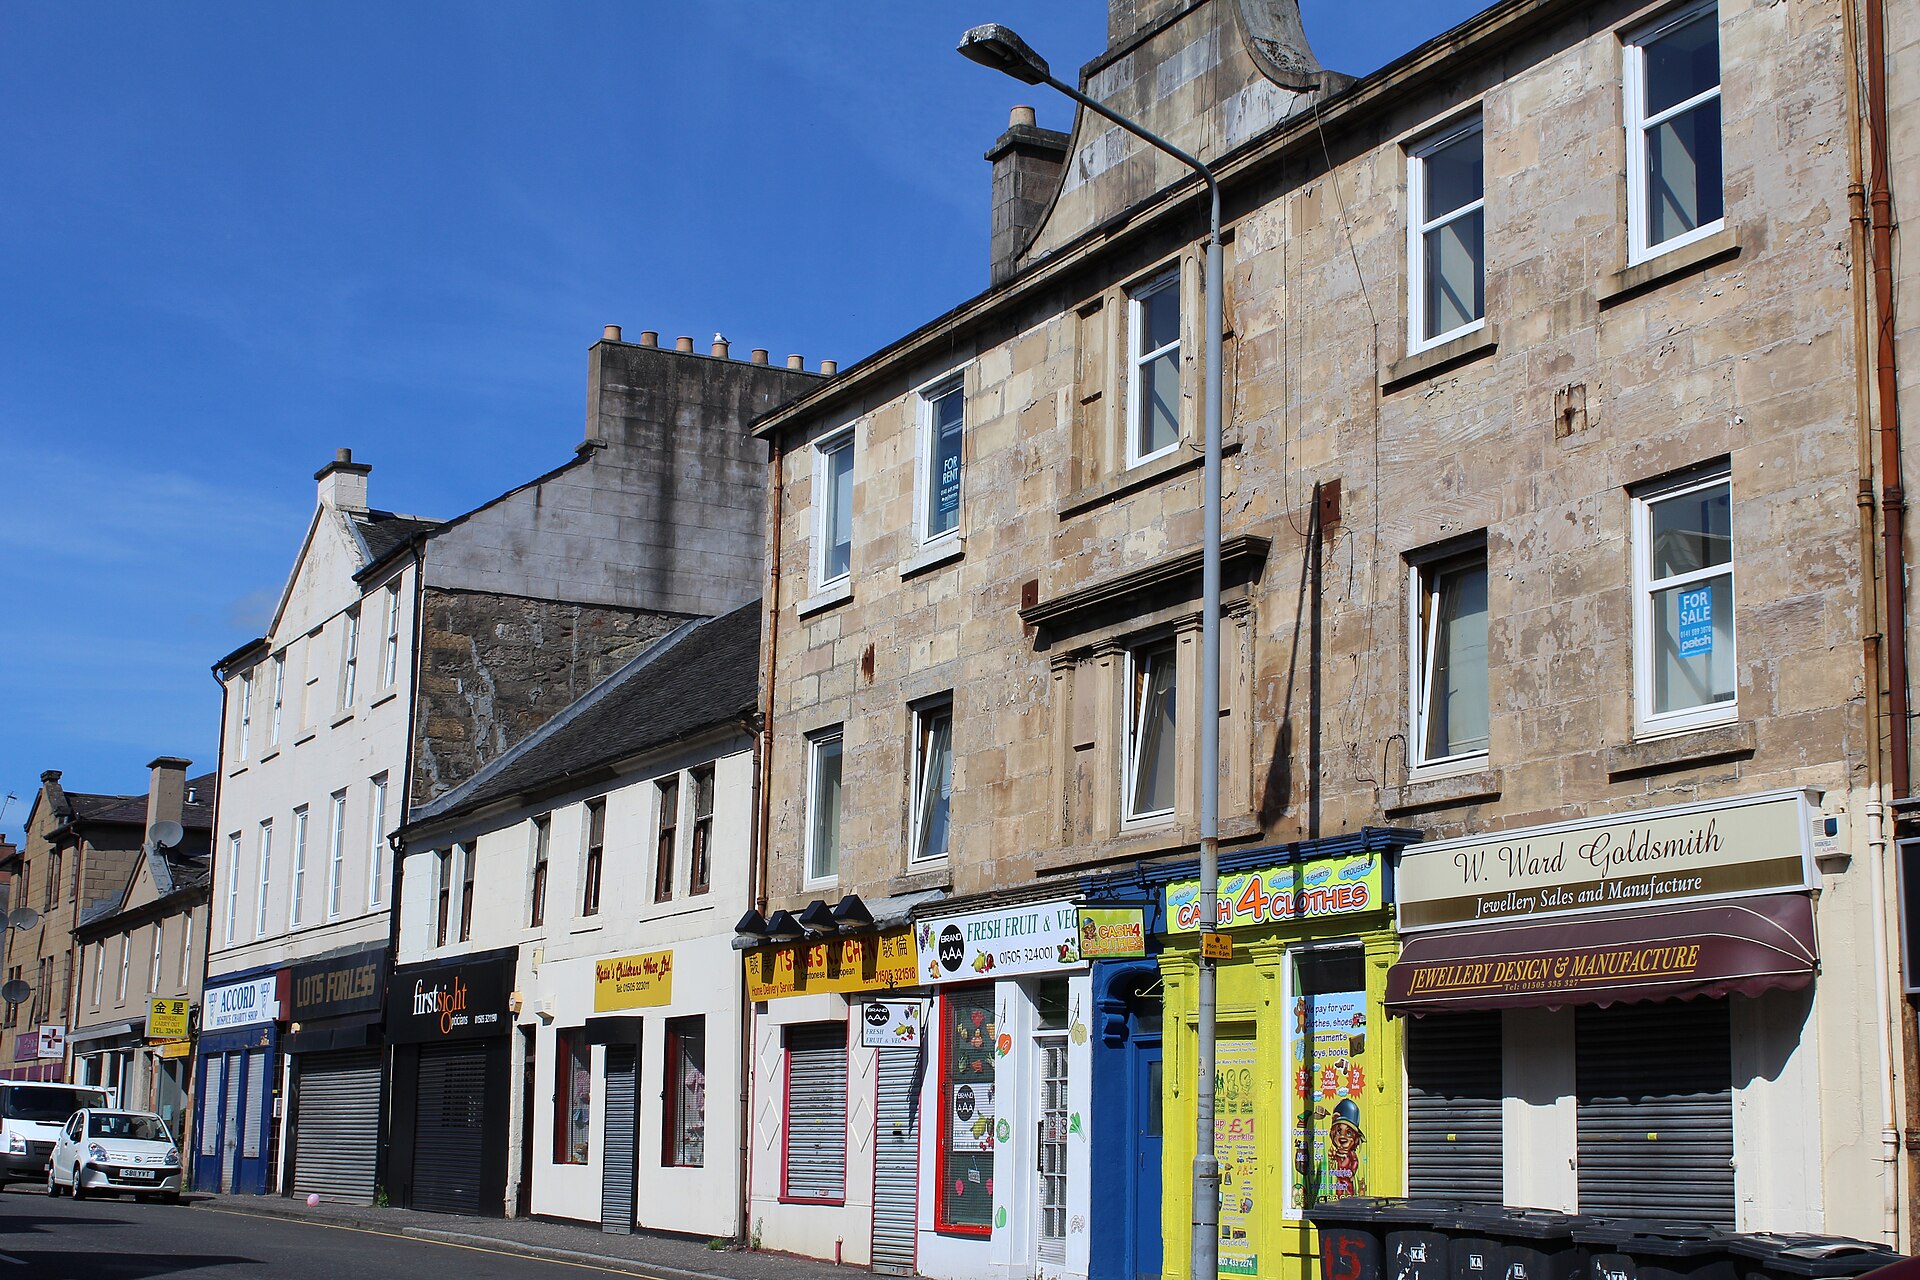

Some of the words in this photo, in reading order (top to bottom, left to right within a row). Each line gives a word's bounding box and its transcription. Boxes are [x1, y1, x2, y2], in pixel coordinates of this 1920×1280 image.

[944, 455, 958, 472] FOR
[942, 467, 959, 485] RENT
[1683, 591, 1708, 610] FOR
[1680, 606, 1711, 626] SALE
[1681, 634, 1712, 652] patch
[1454, 850, 1488, 884] W.
[1498, 841, 1567, 878] Ward
[1578, 817, 1725, 879] Goldsmith
[1305, 869, 1331, 881] T-SHIRTS
[1342, 859, 1372, 877] TROUSERS
[1174, 889, 1191, 902] BAGS
[1177, 899, 1232, 927] CAH
[1235, 877, 1269, 919] 4
[1271, 886, 1369, 916] CLOTHES
[1475, 891, 1537, 919] Jewellery
[1540, 886, 1574, 908] Sales
[1577, 881, 1604, 903] and
[1607, 875, 1702, 901] Manufacture
[966, 919, 1002, 942] FRESH
[1004, 913, 1039, 938] FRUIT
[1043, 914, 1051, 932] &
[941, 933, 962, 944] BRAND
[1081, 936, 1144, 951] CLOTHES
[941, 946, 963, 961] AAA
[999, 950, 1021, 965] 01505
[1024, 946, 1053, 962] 324001
[643, 956, 658, 976] Wear
[801, 971, 826, 980] Cantonese
[832, 967, 856, 978] European
[1406, 963, 1495, 997] JEWELLERY
[1492, 957, 1554, 984] DESIGN
[1553, 956, 1570, 979] &
[1569, 944, 1701, 978] MANUFACTURE
[875, 969, 893, 983] 01505
[894, 966, 916, 981] 321518
[296, 973, 324, 1008] LOTS
[623, 981, 635, 992] 01505
[752, 985, 763, 997] Home
[763, 984, 779, 997] Delivery
[779, 980, 796, 993] Service
[1504, 982, 1521, 991] Tel:
[1522, 981, 1546, 990] 01505
[1547, 980, 1562, 988] 335
[1563, 978, 1579, 987] 327
[220, 984, 256, 1013] ACCORD
[153, 1001, 185, 1015] 金星
[1315, 1006, 1328, 1016] pay
[1327, 1003, 1339, 1012] for
[1338, 1003, 1355, 1014] your
[216, 1014, 232, 1026] HOSPICE
[231, 1011, 247, 1024] CHARITY
[247, 1010, 259, 1021] SHOP
[867, 1013, 888, 1021] AAA
[1305, 1019, 1332, 1028] clothes,
[1311, 1033, 1348, 1043] ornaments
[1328, 1046, 1348, 1057] books
[1325, 1069, 1335, 1079] 20p
[1353, 1069, 1360, 1079] 5p
[957, 1091, 974, 1099] BRAND
[957, 1101, 974, 1113] AAA
[1215, 1119, 1225, 1130] up
[1229, 1118, 1255, 1134] £1
[1293, 1128, 1313, 1138] Opening
[1313, 1128, 1329, 1136] Hours
[1215, 1132, 1225, 1141] to
[1325, 1235, 1366, 1280] 15
